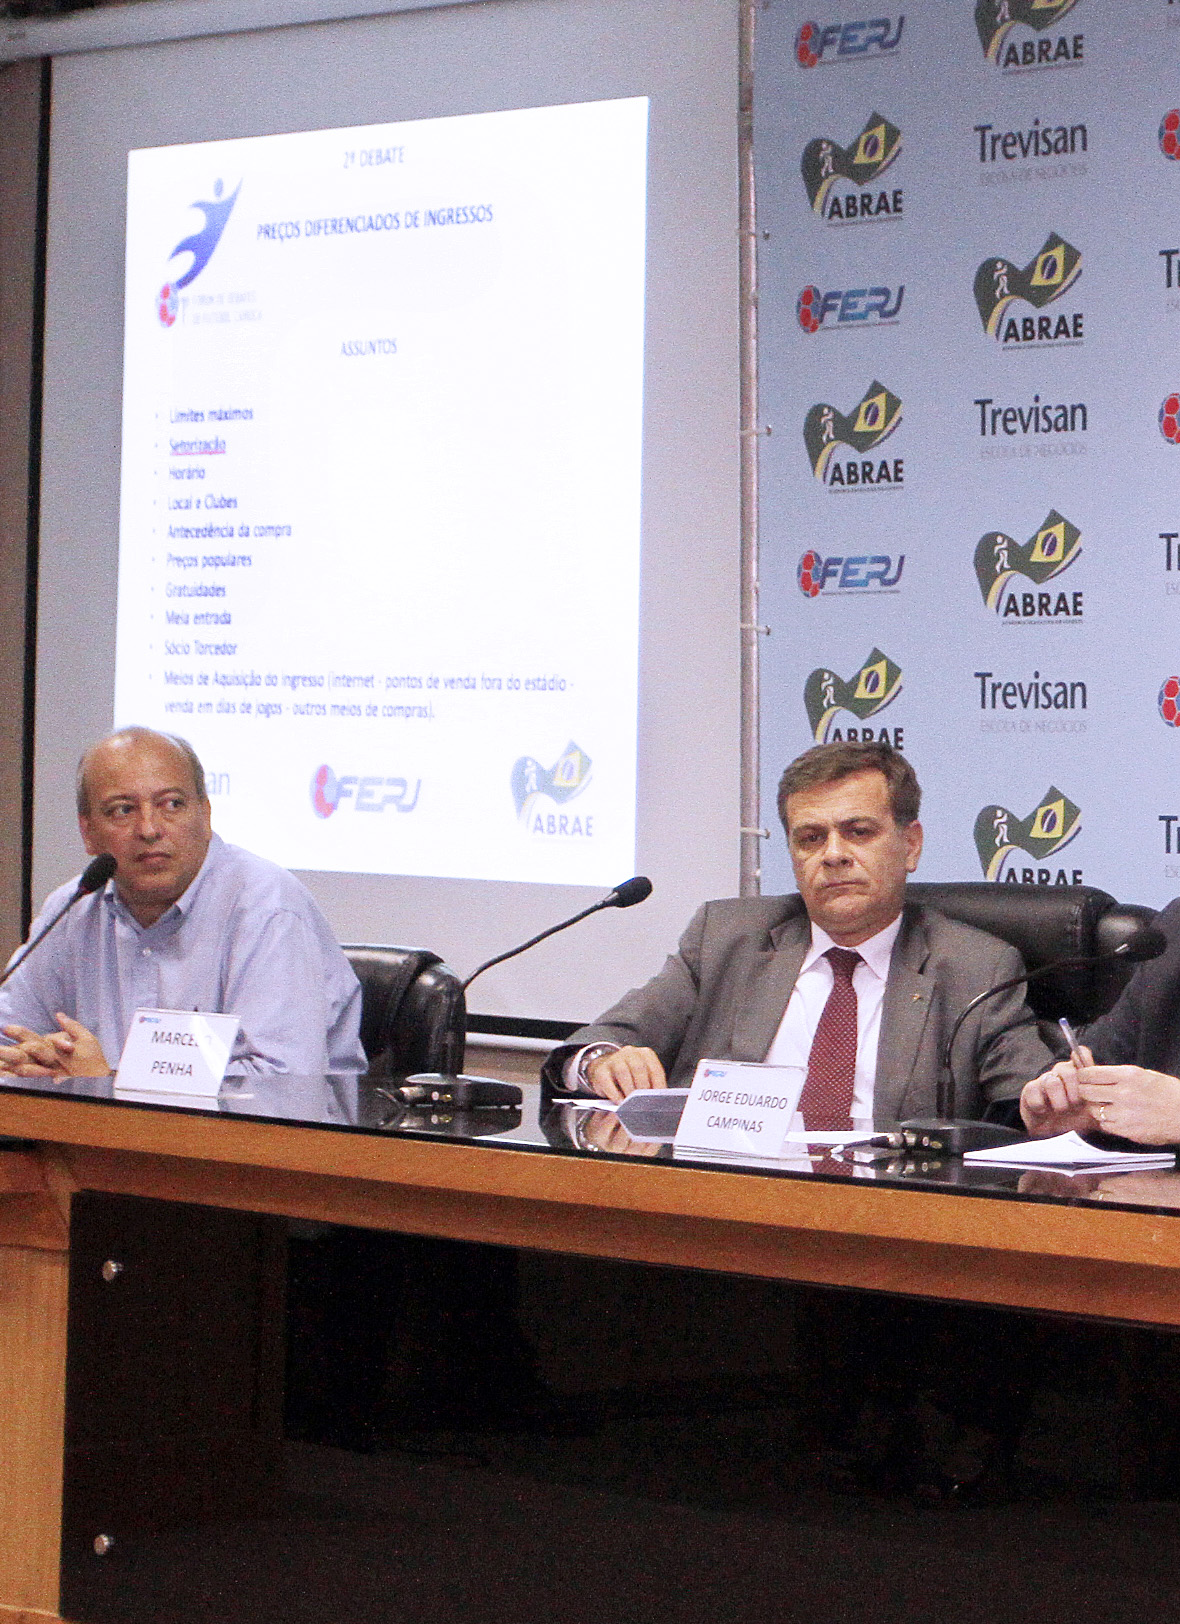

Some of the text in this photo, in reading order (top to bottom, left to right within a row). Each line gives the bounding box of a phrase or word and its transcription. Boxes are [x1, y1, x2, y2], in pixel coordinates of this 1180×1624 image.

[1003, 35, 1084, 67] ABRAE
[974, 118, 1087, 162] Trevisan
[360, 146, 405, 167] DEBATE
[828, 190, 903, 220] ABRAE
[257, 204, 493, 243] PREÇOS DIFERENCIADOS DE INGRESSOS
[1003, 313, 1084, 343] ABRAE
[340, 338, 397, 357] ASSUNTOS
[208, 406, 253, 421] máximos
[974, 394, 1087, 435] Trevisan
[169, 465, 205, 480] Horário
[829, 459, 904, 486] ABRAE
[168, 493, 237, 510] Local e Clubes
[168, 522, 292, 540] Antecedência da compra
[167, 551, 252, 570] Preços populares
[165, 582, 225, 598] Gratuidades
[1003, 592, 1083, 617] ABRAE
[165, 609, 231, 625] Meia entrada
[194, 639, 237, 655] Torcedor
[165, 671, 193, 685] Meios
[197, 671, 209, 686] de
[213, 669, 261, 689] Aquisição
[265, 671, 278, 686] do
[282, 670, 324, 690] ingresso
[385, 675, 423, 693] pontos
[426, 672, 439, 689] de
[443, 673, 476, 690] venda
[480, 672, 502, 690] fora
[507, 673, 520, 690] do
[524, 673, 566, 691] estádio
[974, 671, 1087, 709] Trevisan
[165, 698, 193, 713] venda
[197, 702, 213, 714] em
[216, 698, 236, 714] dias
[239, 699, 252, 714] de
[256, 699, 282, 718] jogos
[293, 703, 326, 716] outros
[330, 702, 361, 717] meios
[365, 700, 378, 717] de
[533, 814, 593, 838] ABRAE
[151, 1061, 192, 1076] PENHA
[698, 1089, 788, 1109] JORGE EDUARDO
[707, 1115, 763, 1133] CAMPINAS
